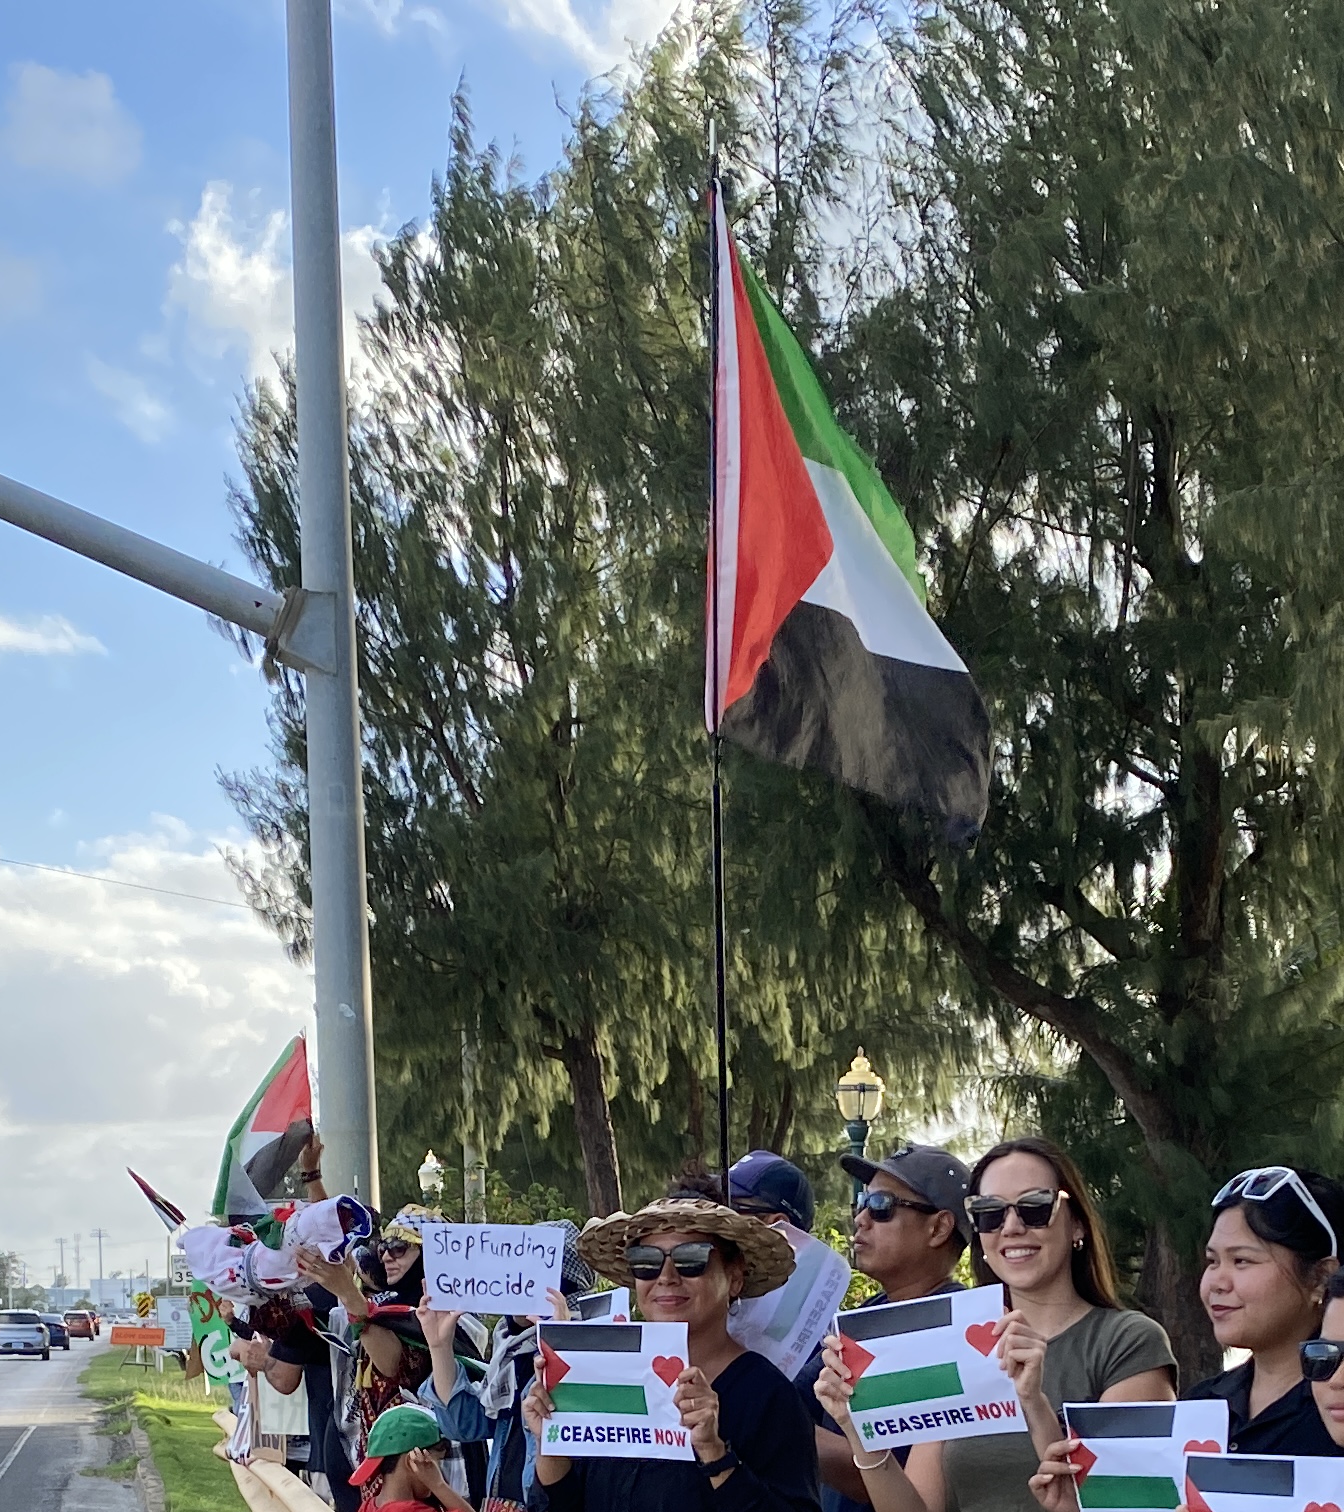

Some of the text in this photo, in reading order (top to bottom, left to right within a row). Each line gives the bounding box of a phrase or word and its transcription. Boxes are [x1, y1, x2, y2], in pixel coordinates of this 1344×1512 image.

[434, 1226, 557, 1269] Stop Funding
[174, 1271, 193, 1283] 35
[436, 1272, 536, 1298] Genocide
[861, 1400, 1017, 1440] #CEASEFIRE NOW
[547, 1424, 687, 1447] #CEASEFIRE NOW
